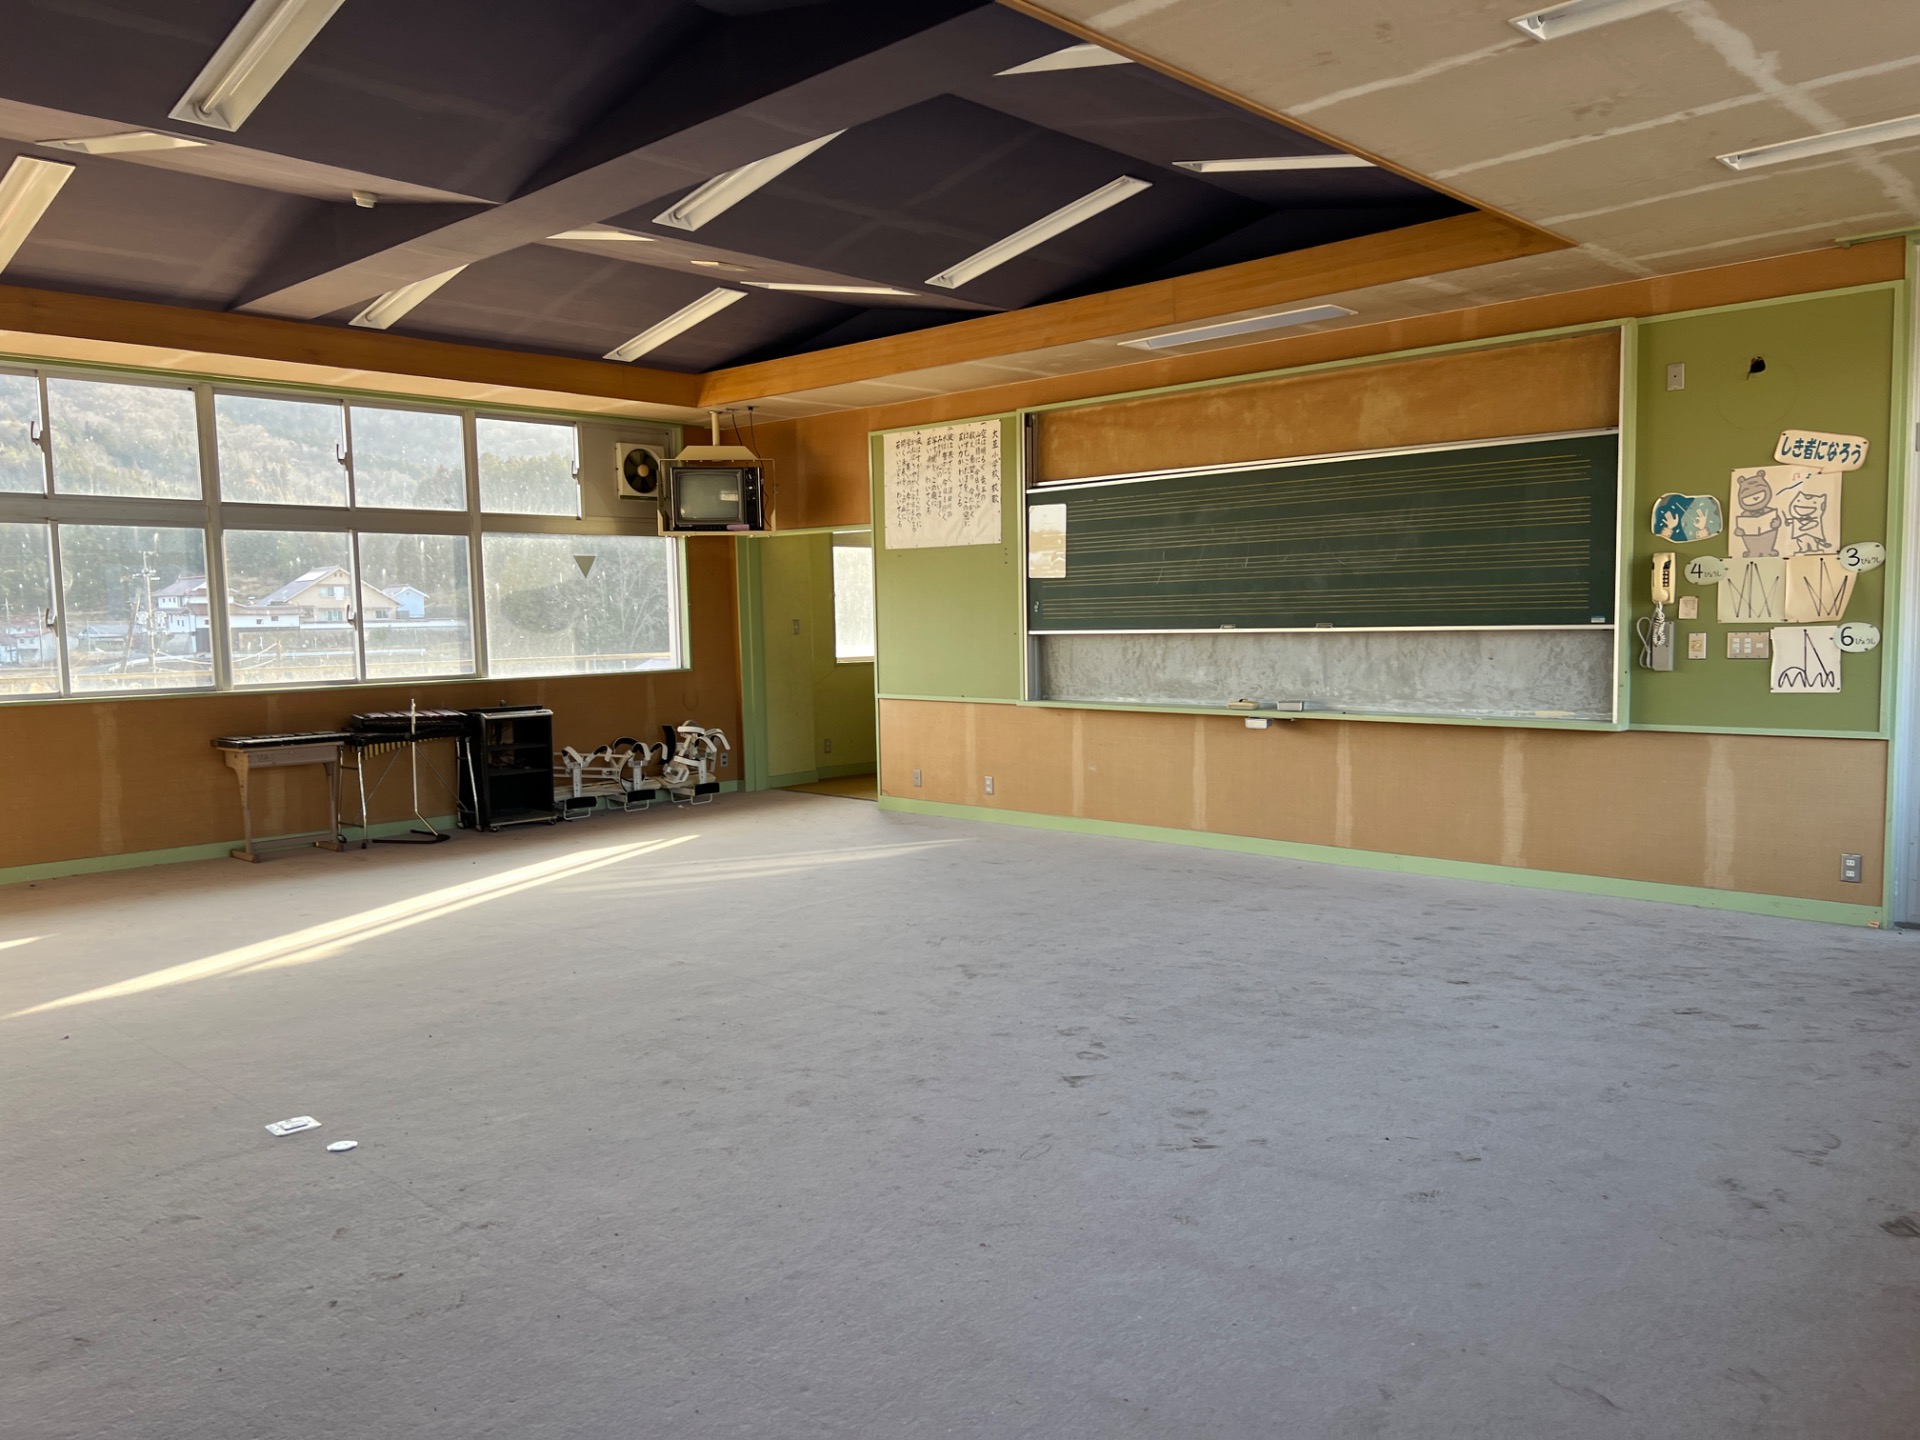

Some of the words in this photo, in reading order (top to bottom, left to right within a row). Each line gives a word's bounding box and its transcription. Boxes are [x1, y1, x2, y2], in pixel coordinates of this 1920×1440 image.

[1781, 436, 1861, 464] しき者になろう
